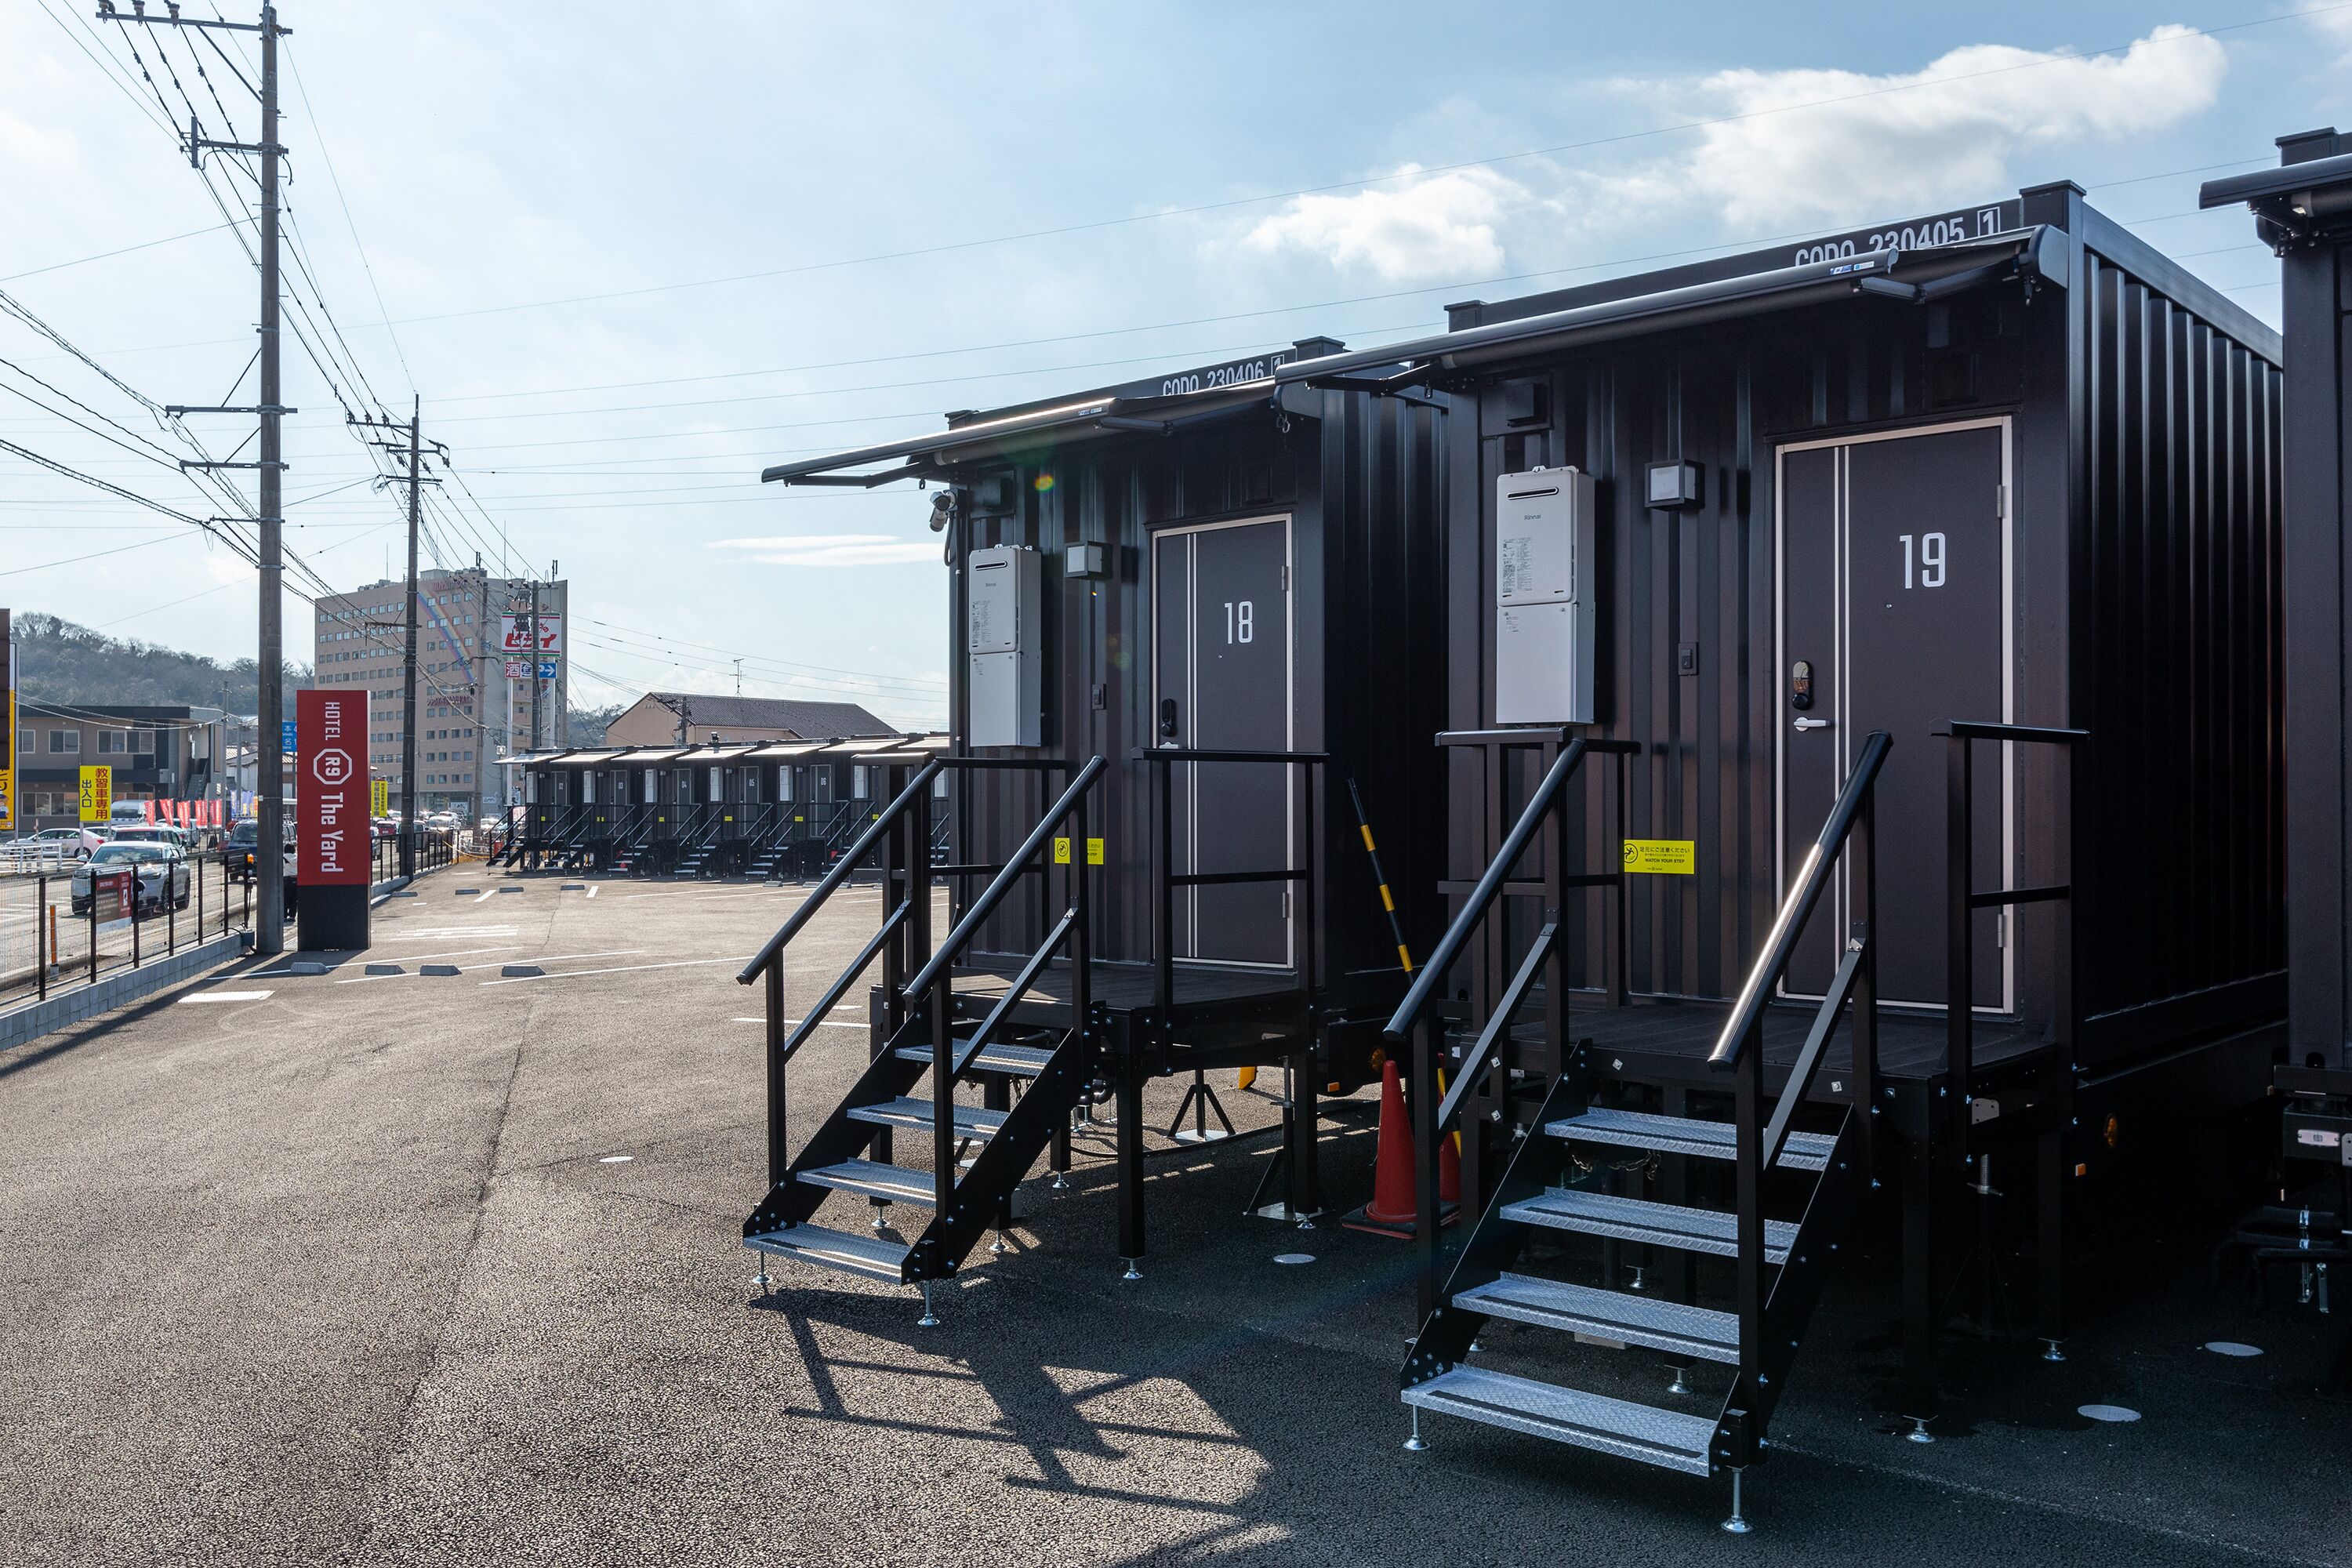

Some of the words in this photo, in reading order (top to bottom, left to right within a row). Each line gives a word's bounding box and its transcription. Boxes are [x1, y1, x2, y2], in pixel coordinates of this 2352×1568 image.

[1869, 217, 1965, 251] 230405
[1207, 361, 1265, 388] 230406
[1900, 532, 1946, 590] 19
[1224, 601, 1253, 644] 18
[506, 664, 520, 677] 酒
[325, 702, 340, 741] HOTEL
[325, 757, 341, 776] R9
[82, 780, 93, 808] 出入口
[95, 768, 108, 819] 教習車専用
[321, 792, 343, 825] The
[321, 829, 343, 872] Yard
